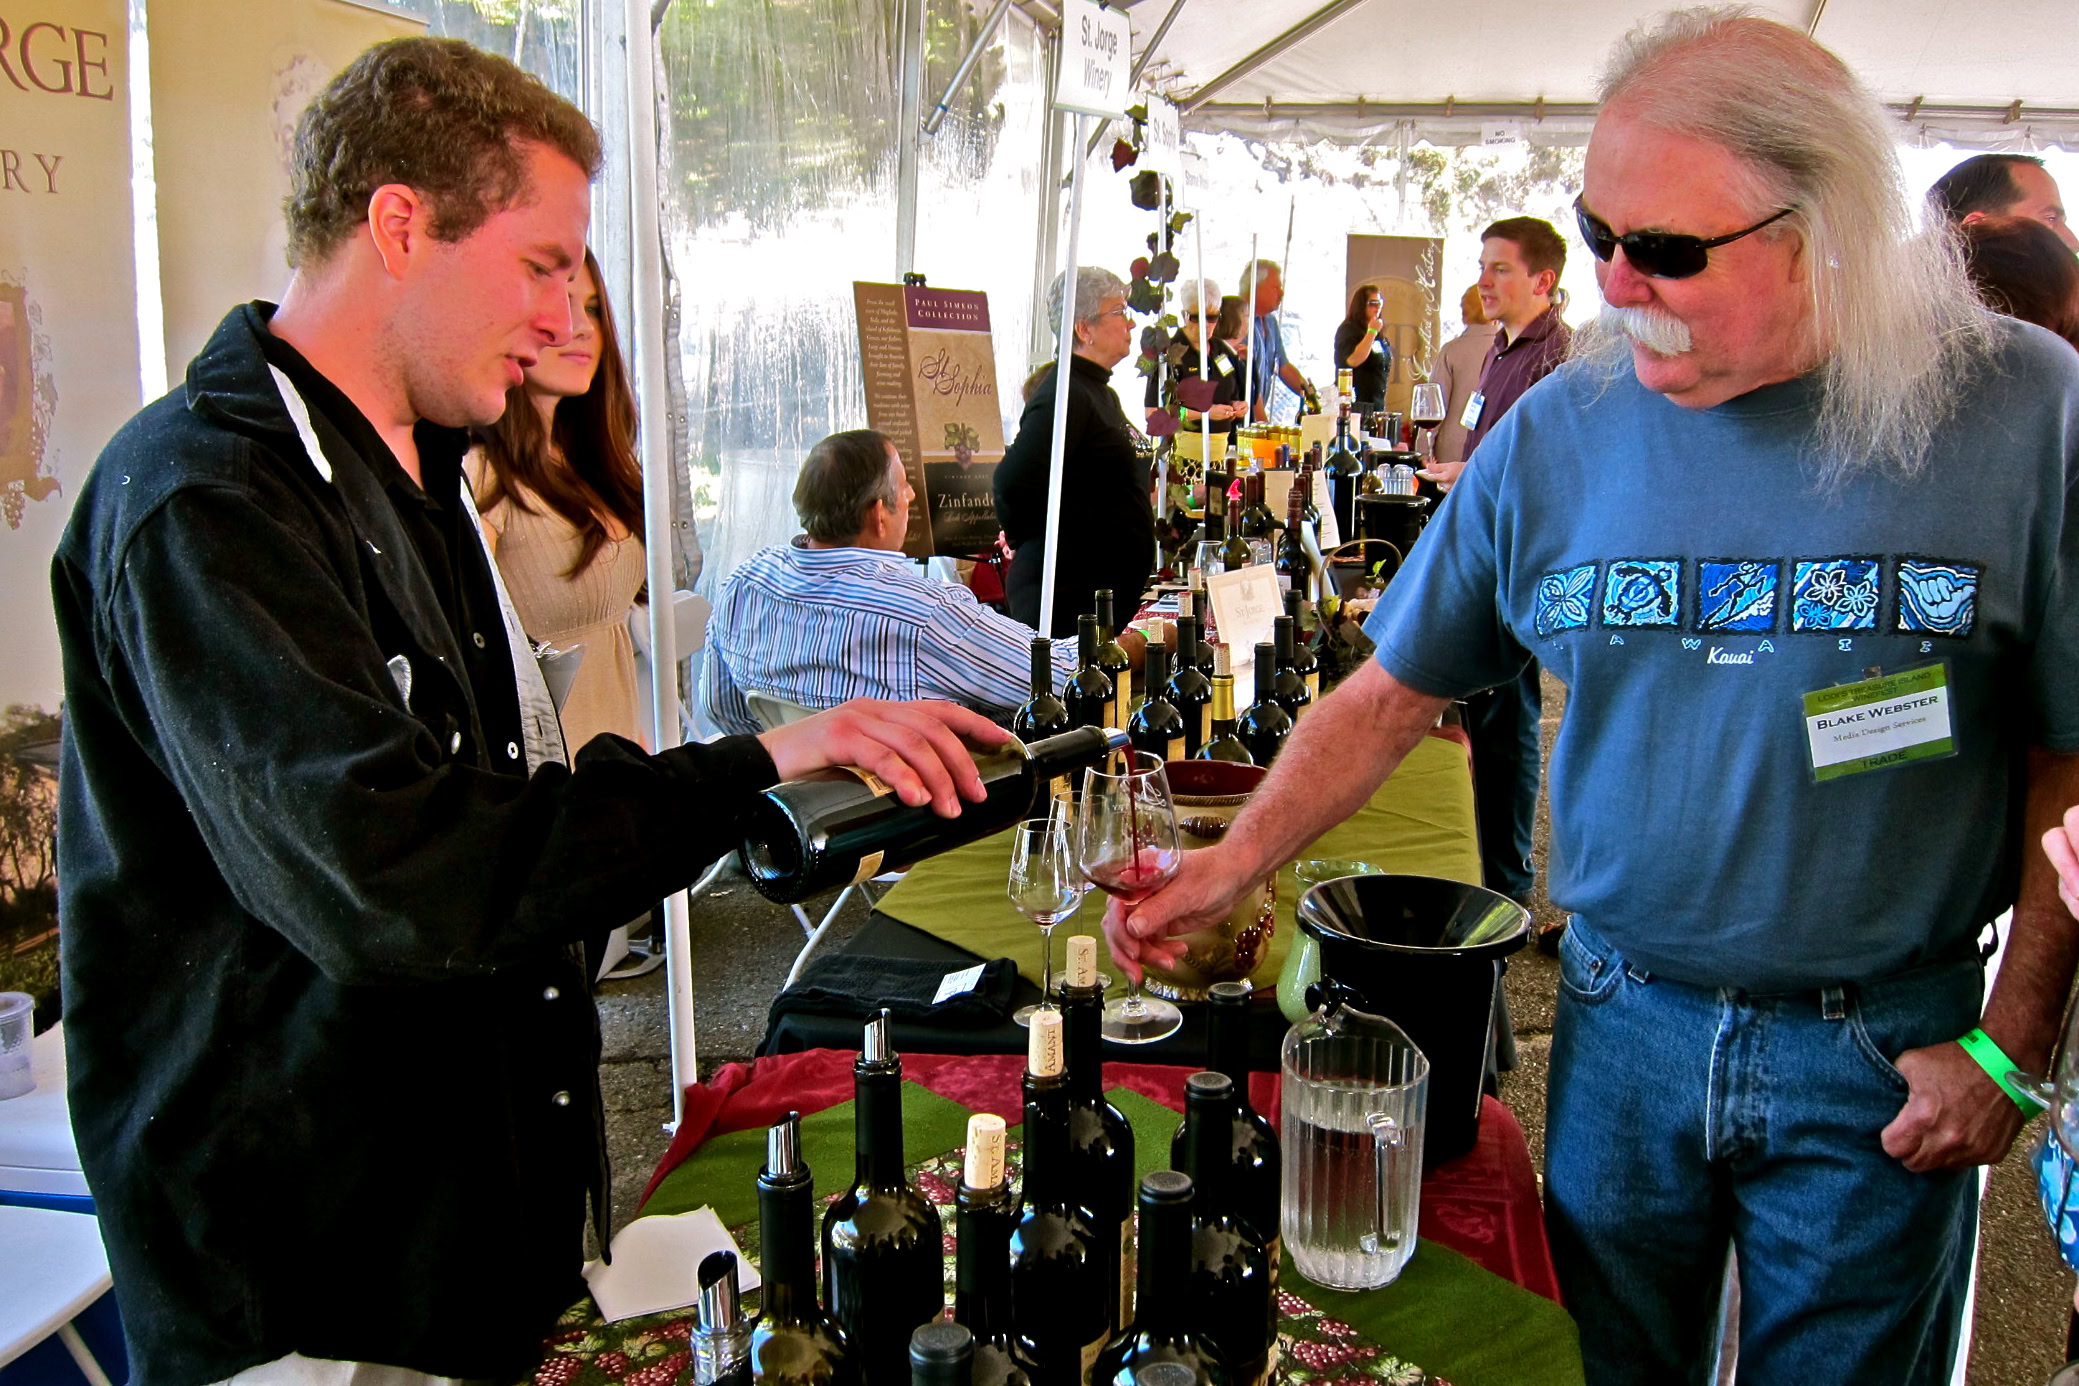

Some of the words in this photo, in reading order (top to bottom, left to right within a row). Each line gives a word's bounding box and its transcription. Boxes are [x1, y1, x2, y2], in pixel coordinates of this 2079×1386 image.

[1081, 14, 1093, 48] St.
[1094, 20, 1118, 62] Jorge
[1084, 57, 1113, 99] Winery
[1485, 137, 1516, 145] SMOKING
[915, 298, 939, 308] PAUL
[943, 299, 980, 311] SIMEON
[917, 309, 979, 321] COLLECTION
[933, 364, 992, 407] Sophia
[1706, 646, 1755, 665] Kauai
[1816, 712, 1865, 730] BLAKE
[1868, 695, 1939, 719] WEBSTER
[1833, 728, 1860, 743] Media
[1861, 724, 1891, 737] Design
[1893, 715, 1927, 729] Services
[1861, 751, 1908, 769] TRADE
